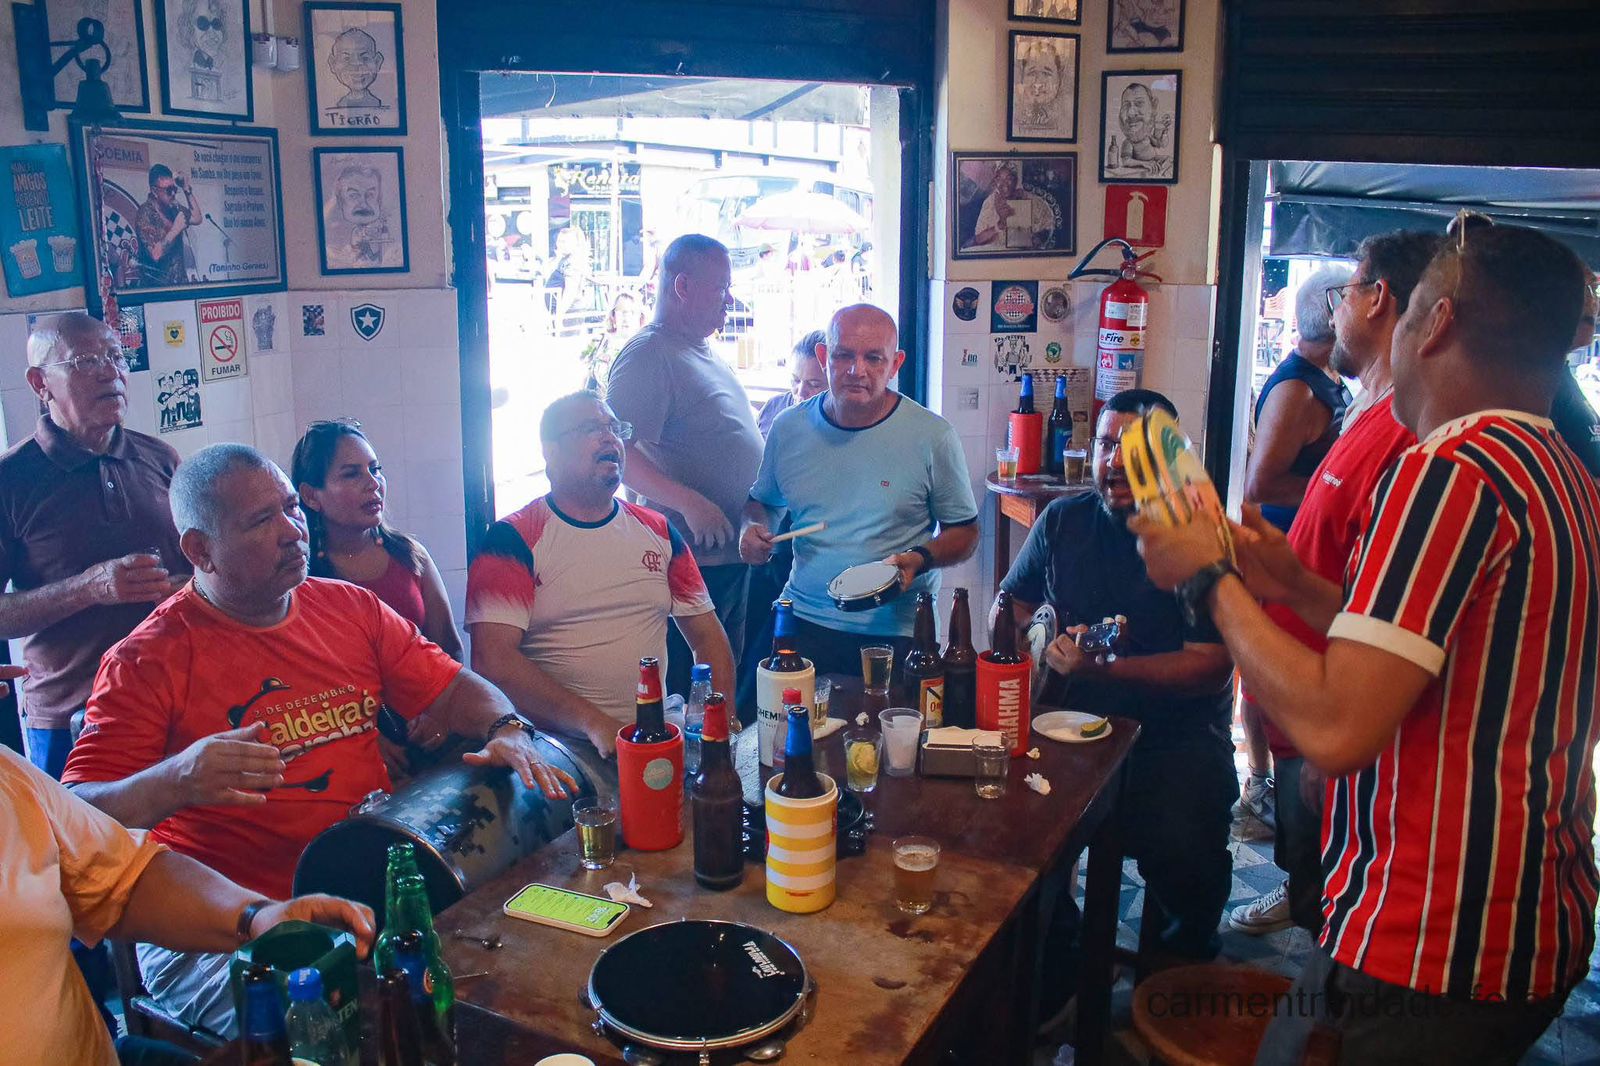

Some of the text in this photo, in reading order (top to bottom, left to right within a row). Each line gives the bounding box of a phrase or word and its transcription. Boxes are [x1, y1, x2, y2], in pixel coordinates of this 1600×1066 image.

[13, 172, 47, 192] AMIGOS
[18, 206, 55, 231] LEITE
[209, 263, 240, 274] (Toninho
[202, 305, 240, 320] PROIBIDO
[211, 364, 241, 375] FUMAR
[266, 704, 284, 715] DE
[286, 684, 356, 710] DEZEMBRO
[267, 701, 362, 746] aldeira
[363, 690, 377, 717] é
[757, 706, 784, 721] HEMI
